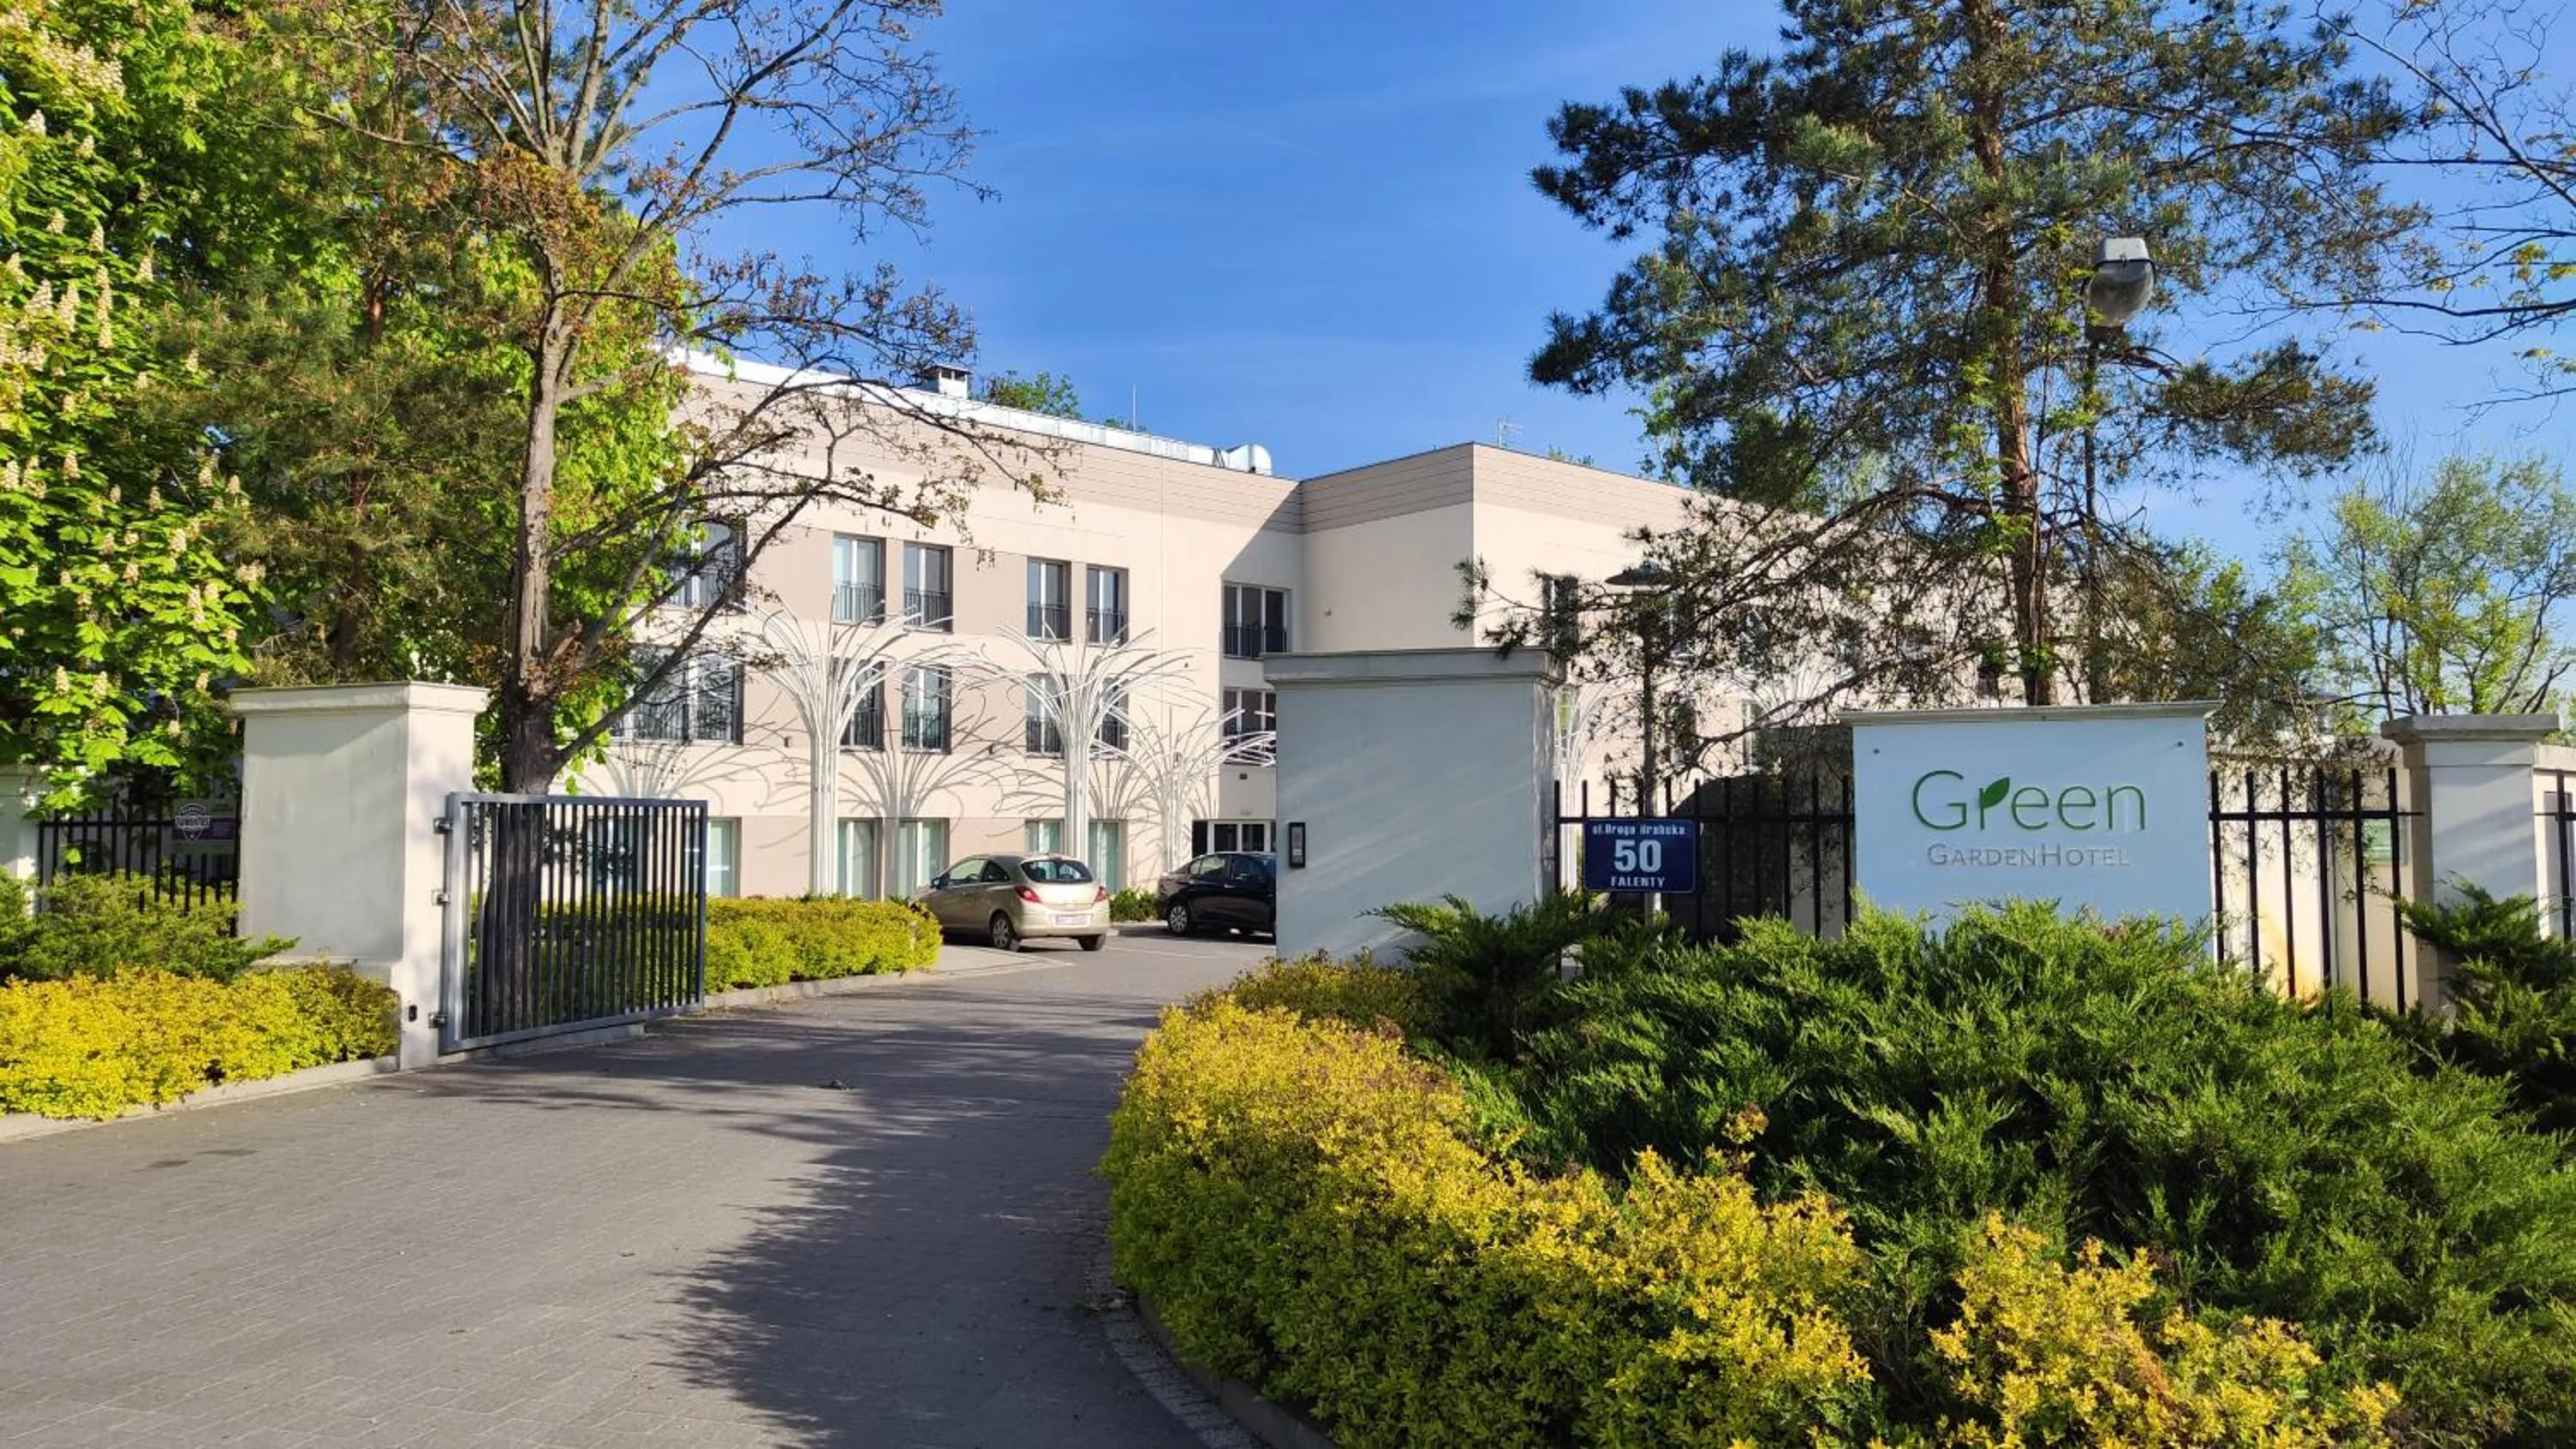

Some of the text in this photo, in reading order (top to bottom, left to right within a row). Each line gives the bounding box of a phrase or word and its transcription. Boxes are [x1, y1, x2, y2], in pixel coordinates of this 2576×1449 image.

[1912, 769, 2146, 831] Green
[1613, 839, 1662, 873] 50
[1611, 876, 1666, 888] FALENTY
